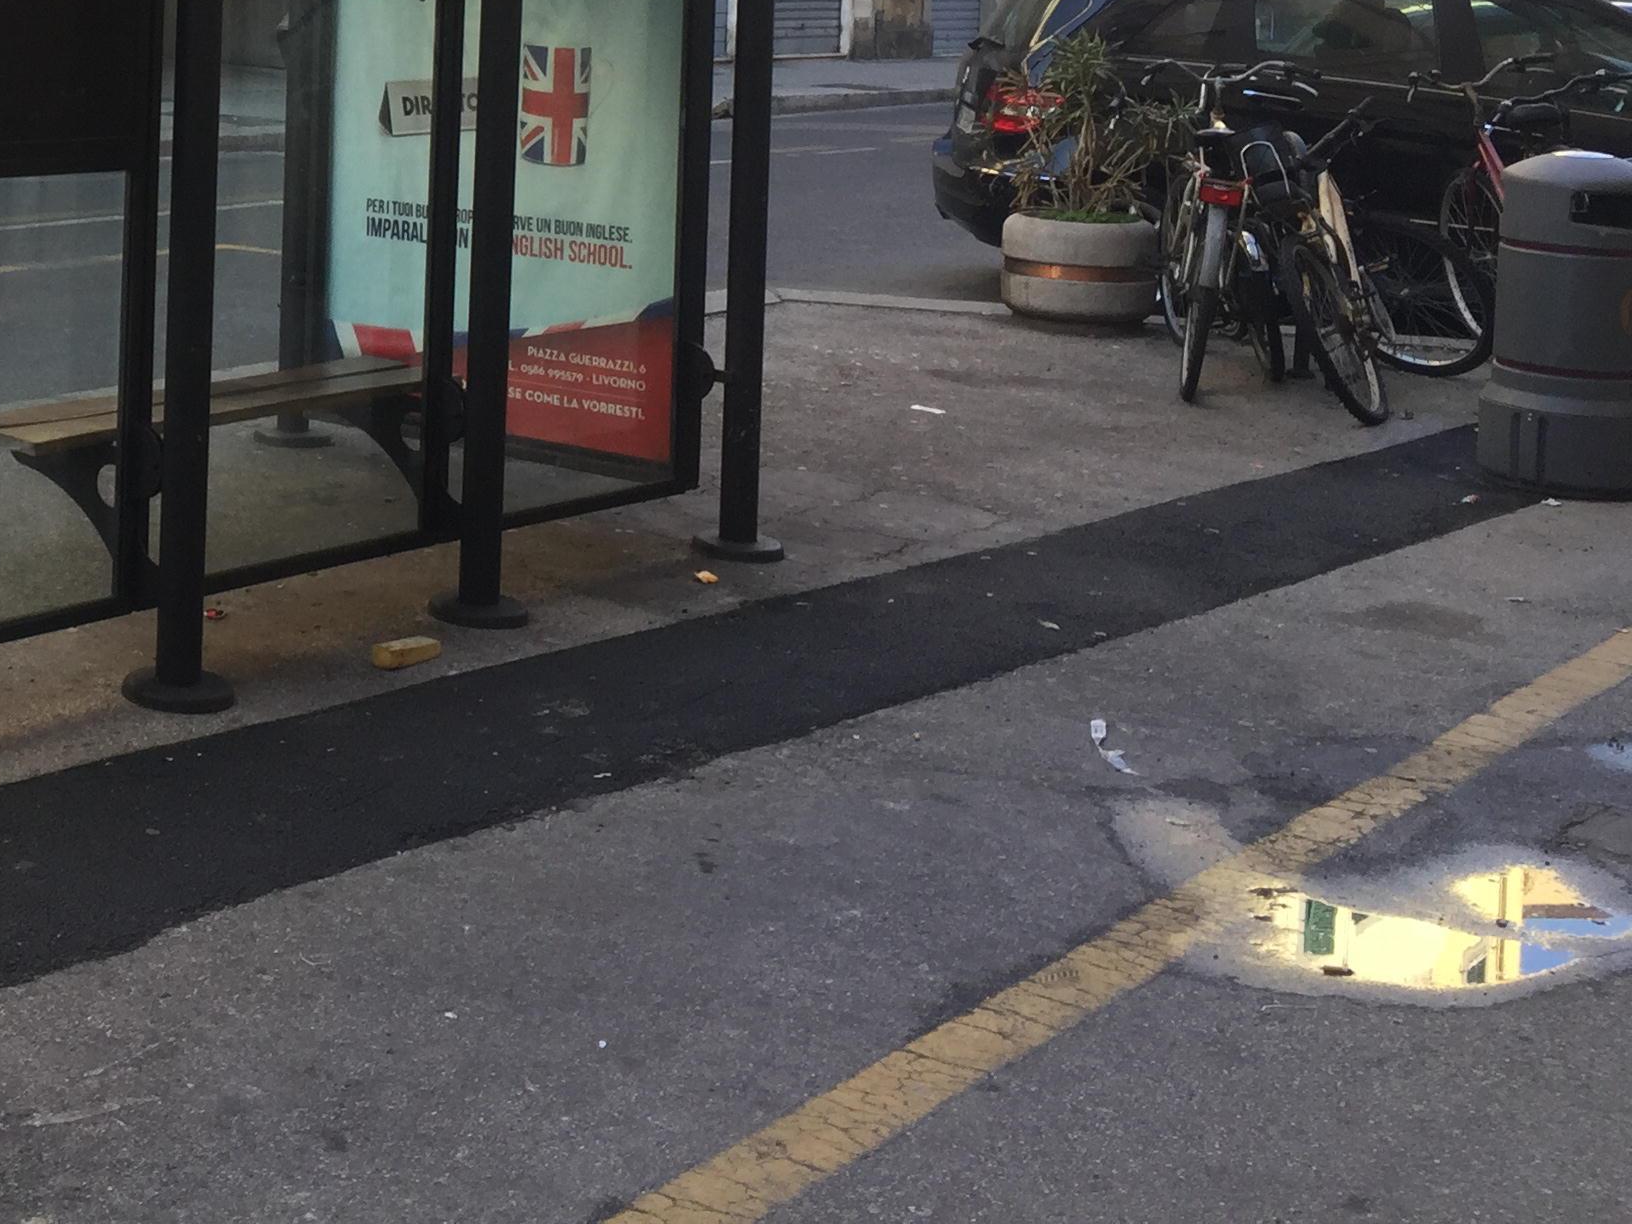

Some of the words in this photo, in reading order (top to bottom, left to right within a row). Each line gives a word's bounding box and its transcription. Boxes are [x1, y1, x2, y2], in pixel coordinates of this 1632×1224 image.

[366, 198, 385, 215] PER
[391, 200, 414, 218] TUOI
[536, 217, 552, 234] UN
[554, 219, 584, 238] BUON
[585, 222, 633, 244] INGLESE.
[568, 240, 633, 270] SCHOOL.
[528, 345, 567, 362] PIAZZA
[638, 363, 647, 375] 6
[591, 373, 647, 392] LIVORNO
[524, 390, 561, 407] COME
[563, 395, 579, 409] LA
